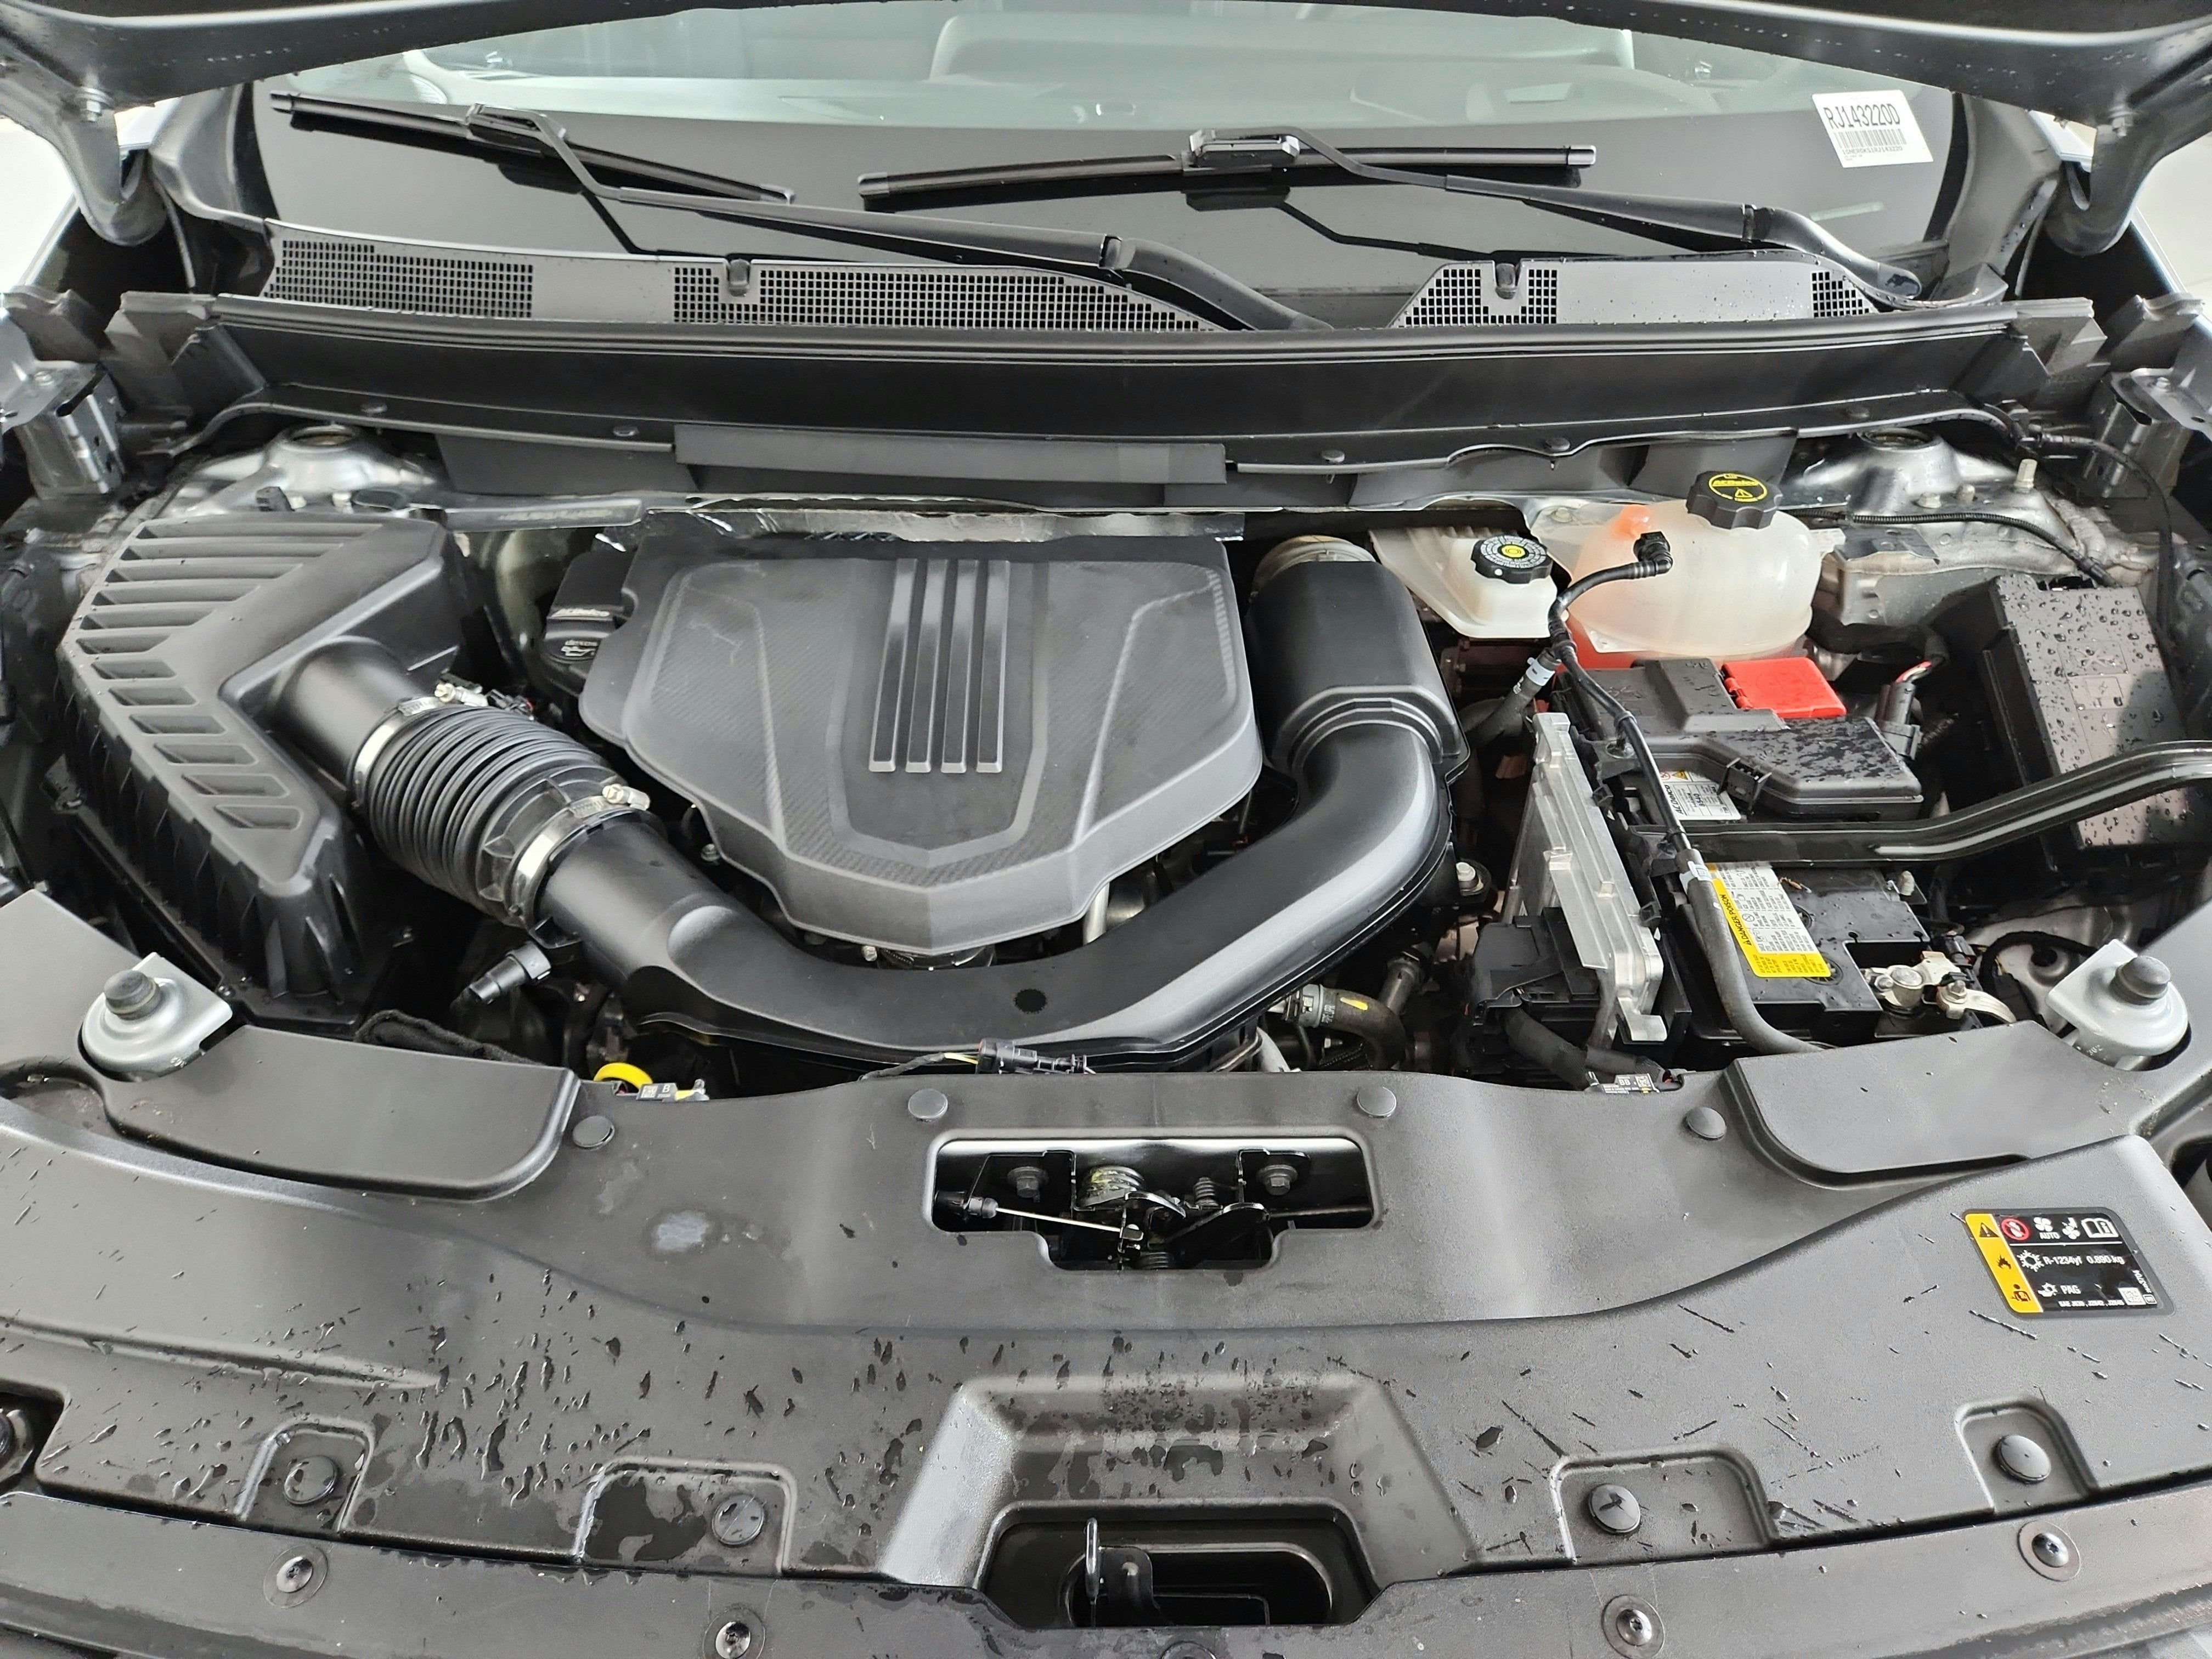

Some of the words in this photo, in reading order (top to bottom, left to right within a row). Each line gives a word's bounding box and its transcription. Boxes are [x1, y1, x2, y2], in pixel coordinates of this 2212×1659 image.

[1823, 103, 1900, 129] RJ143220D
[1664, 785, 1684, 814] ACDelco
[662, 1085, 670, 1093] B
[2042, 1256, 2083, 1266] R-1234yf
[2060, 1285, 2081, 1295] PAG
